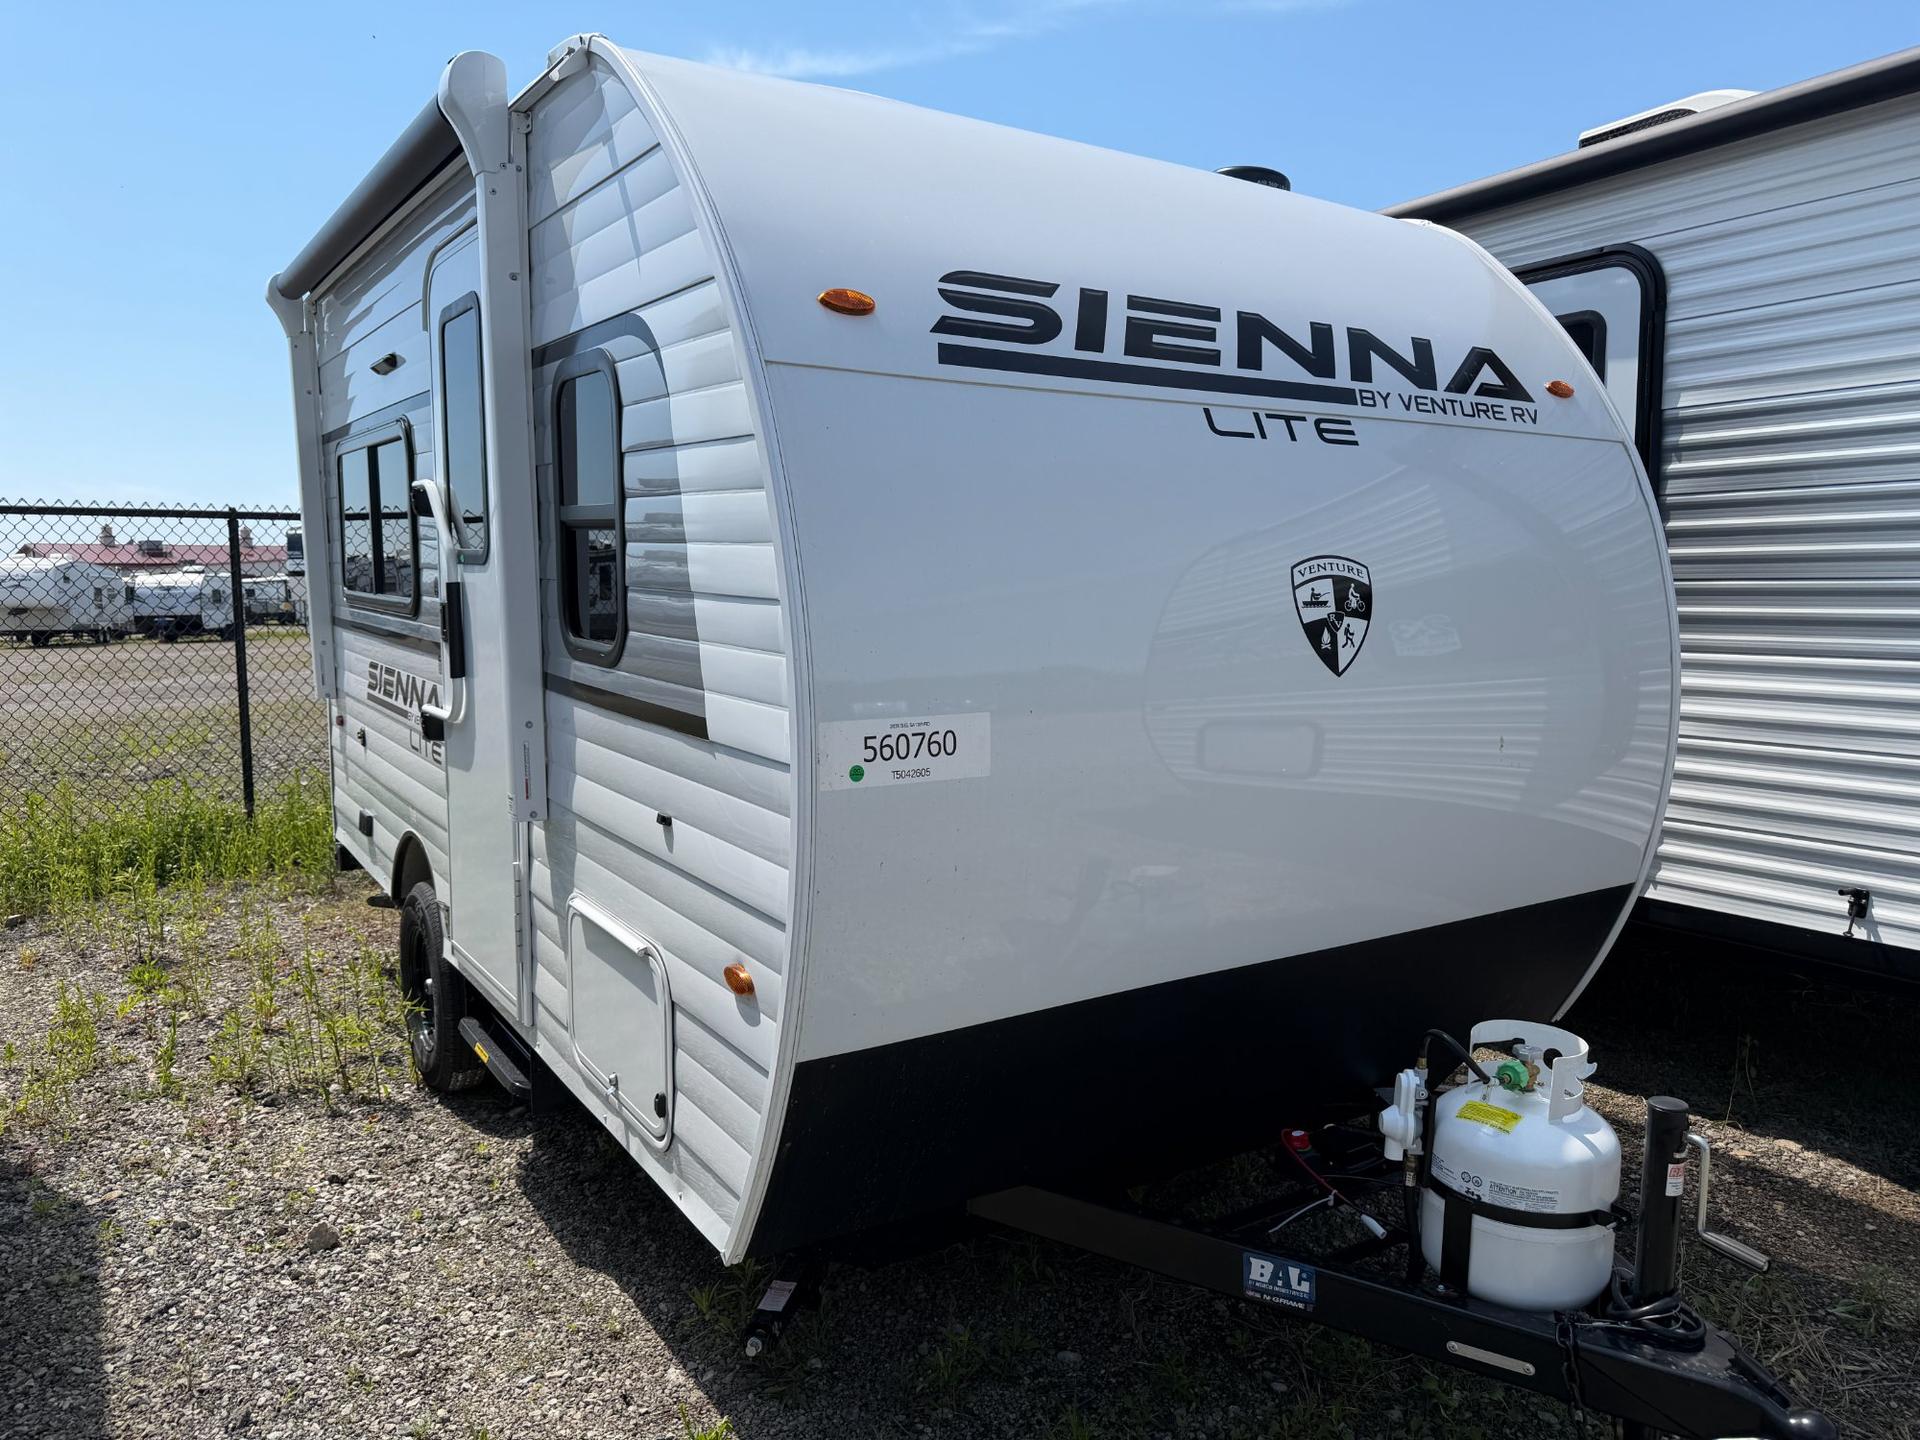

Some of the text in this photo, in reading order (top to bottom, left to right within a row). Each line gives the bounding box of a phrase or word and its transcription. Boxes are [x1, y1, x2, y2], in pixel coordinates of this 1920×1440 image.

[930, 270, 1535, 403] SIENNA
[1358, 389, 1538, 425] BY VENTURE RV
[1202, 407, 1360, 447] LITE
[1297, 561, 1364, 579] VENTURE
[367, 661, 443, 712] SIENNA
[863, 729, 957, 763] 560760
[891, 767, 931, 780] T5042605
[1249, 1256, 1310, 1293] BAL
